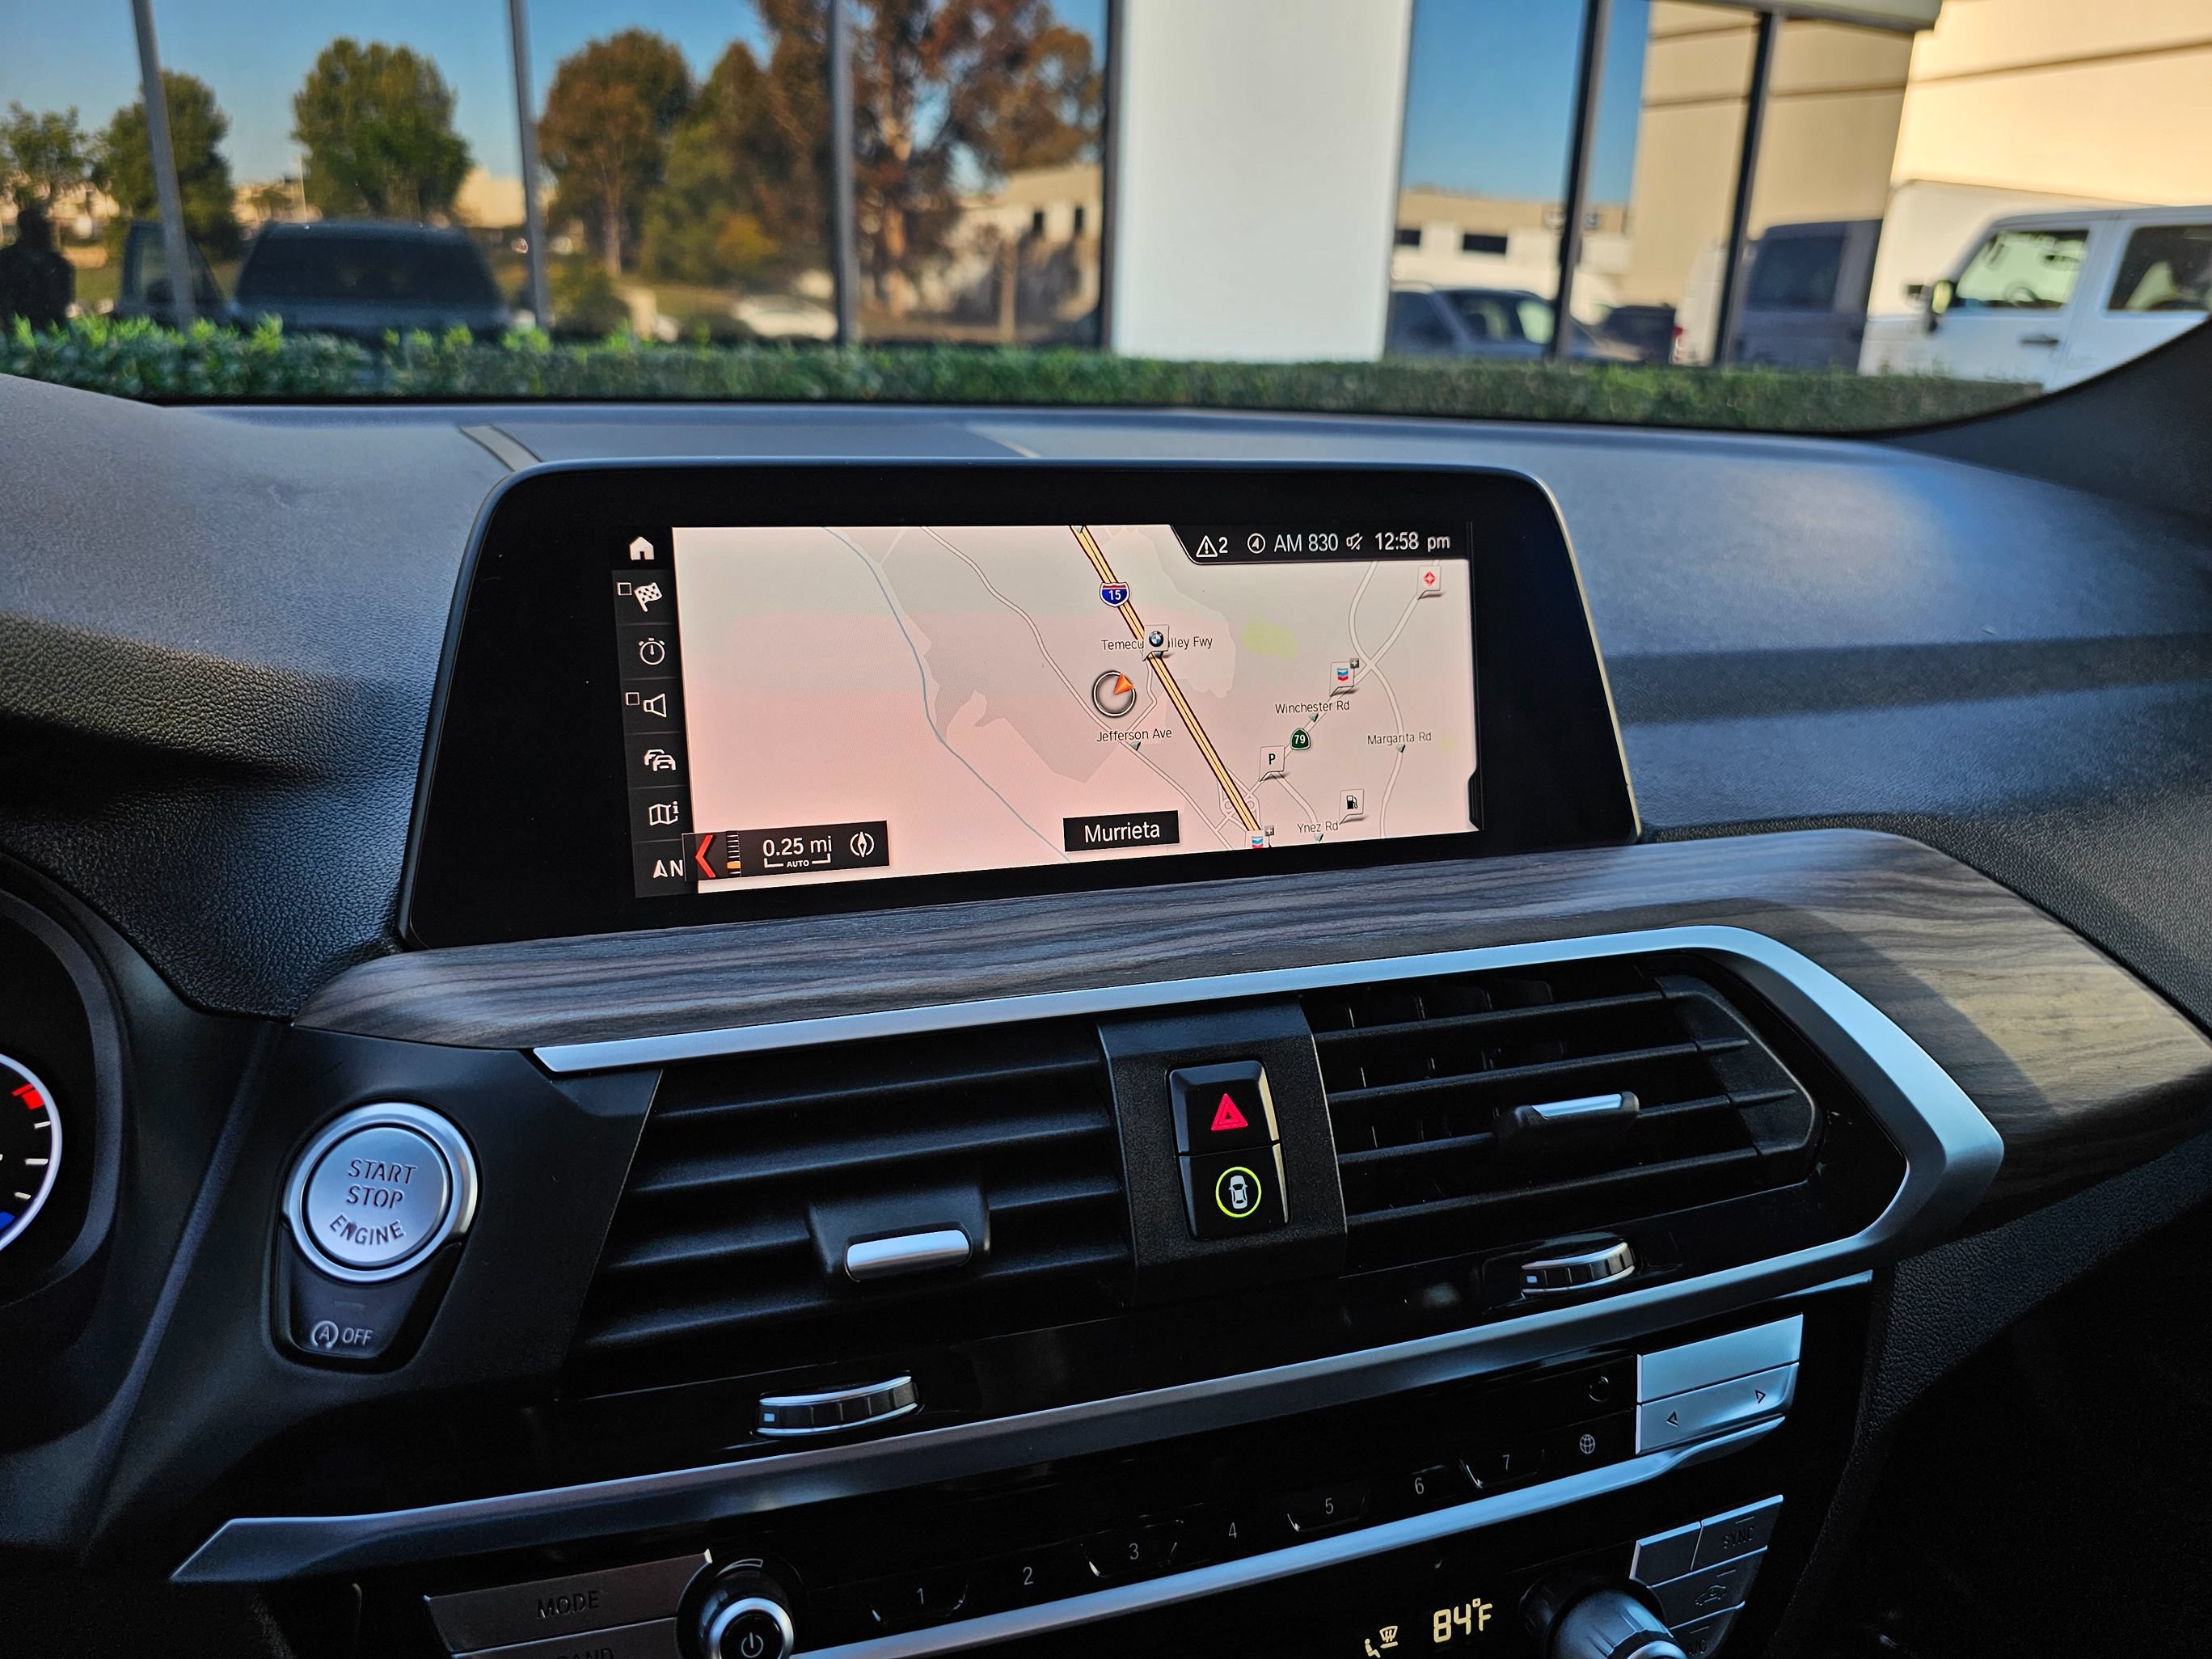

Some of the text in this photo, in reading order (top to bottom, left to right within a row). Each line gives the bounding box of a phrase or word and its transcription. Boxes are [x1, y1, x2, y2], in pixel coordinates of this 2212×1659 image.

[1218, 537, 1228, 554] 2
[1274, 534, 1339, 552] AM 830
[1374, 532, 1451, 552] 12:58 pm
[1108, 589, 1121, 601] 15
[1101, 636, 1213, 651] Temecu lley Fwy
[1275, 700, 1350, 714] Winchester Rd
[1096, 728, 1172, 742] Jefferson Ave
[1294, 734, 1306, 745] 79
[1367, 732, 1432, 745] Margarita Rd
[1269, 753, 1276, 765] P
[1084, 821, 1160, 843] Murrieta
[1297, 821, 1339, 834] Ynez Rd
[762, 835, 833, 857] 0.25 mi
[787, 859, 810, 868] AUTO
[348, 1158, 417, 1184] START
[346, 1184, 404, 1209] STOP
[329, 1214, 406, 1246] ENGINE
[342, 1327, 374, 1346] OFF
[1501, 1454, 1510, 1471] 7
[1415, 1476, 1425, 1495] 6
[1324, 1497, 1334, 1514] 5
[1228, 1522, 1238, 1539] 4
[1721, 1526, 1755, 1550] SYNC
[1129, 1543, 1139, 1560] 3
[1023, 1566, 1034, 1585] 2
[537, 1589, 602, 1619] MODE
[917, 1587, 924, 1604] 1
